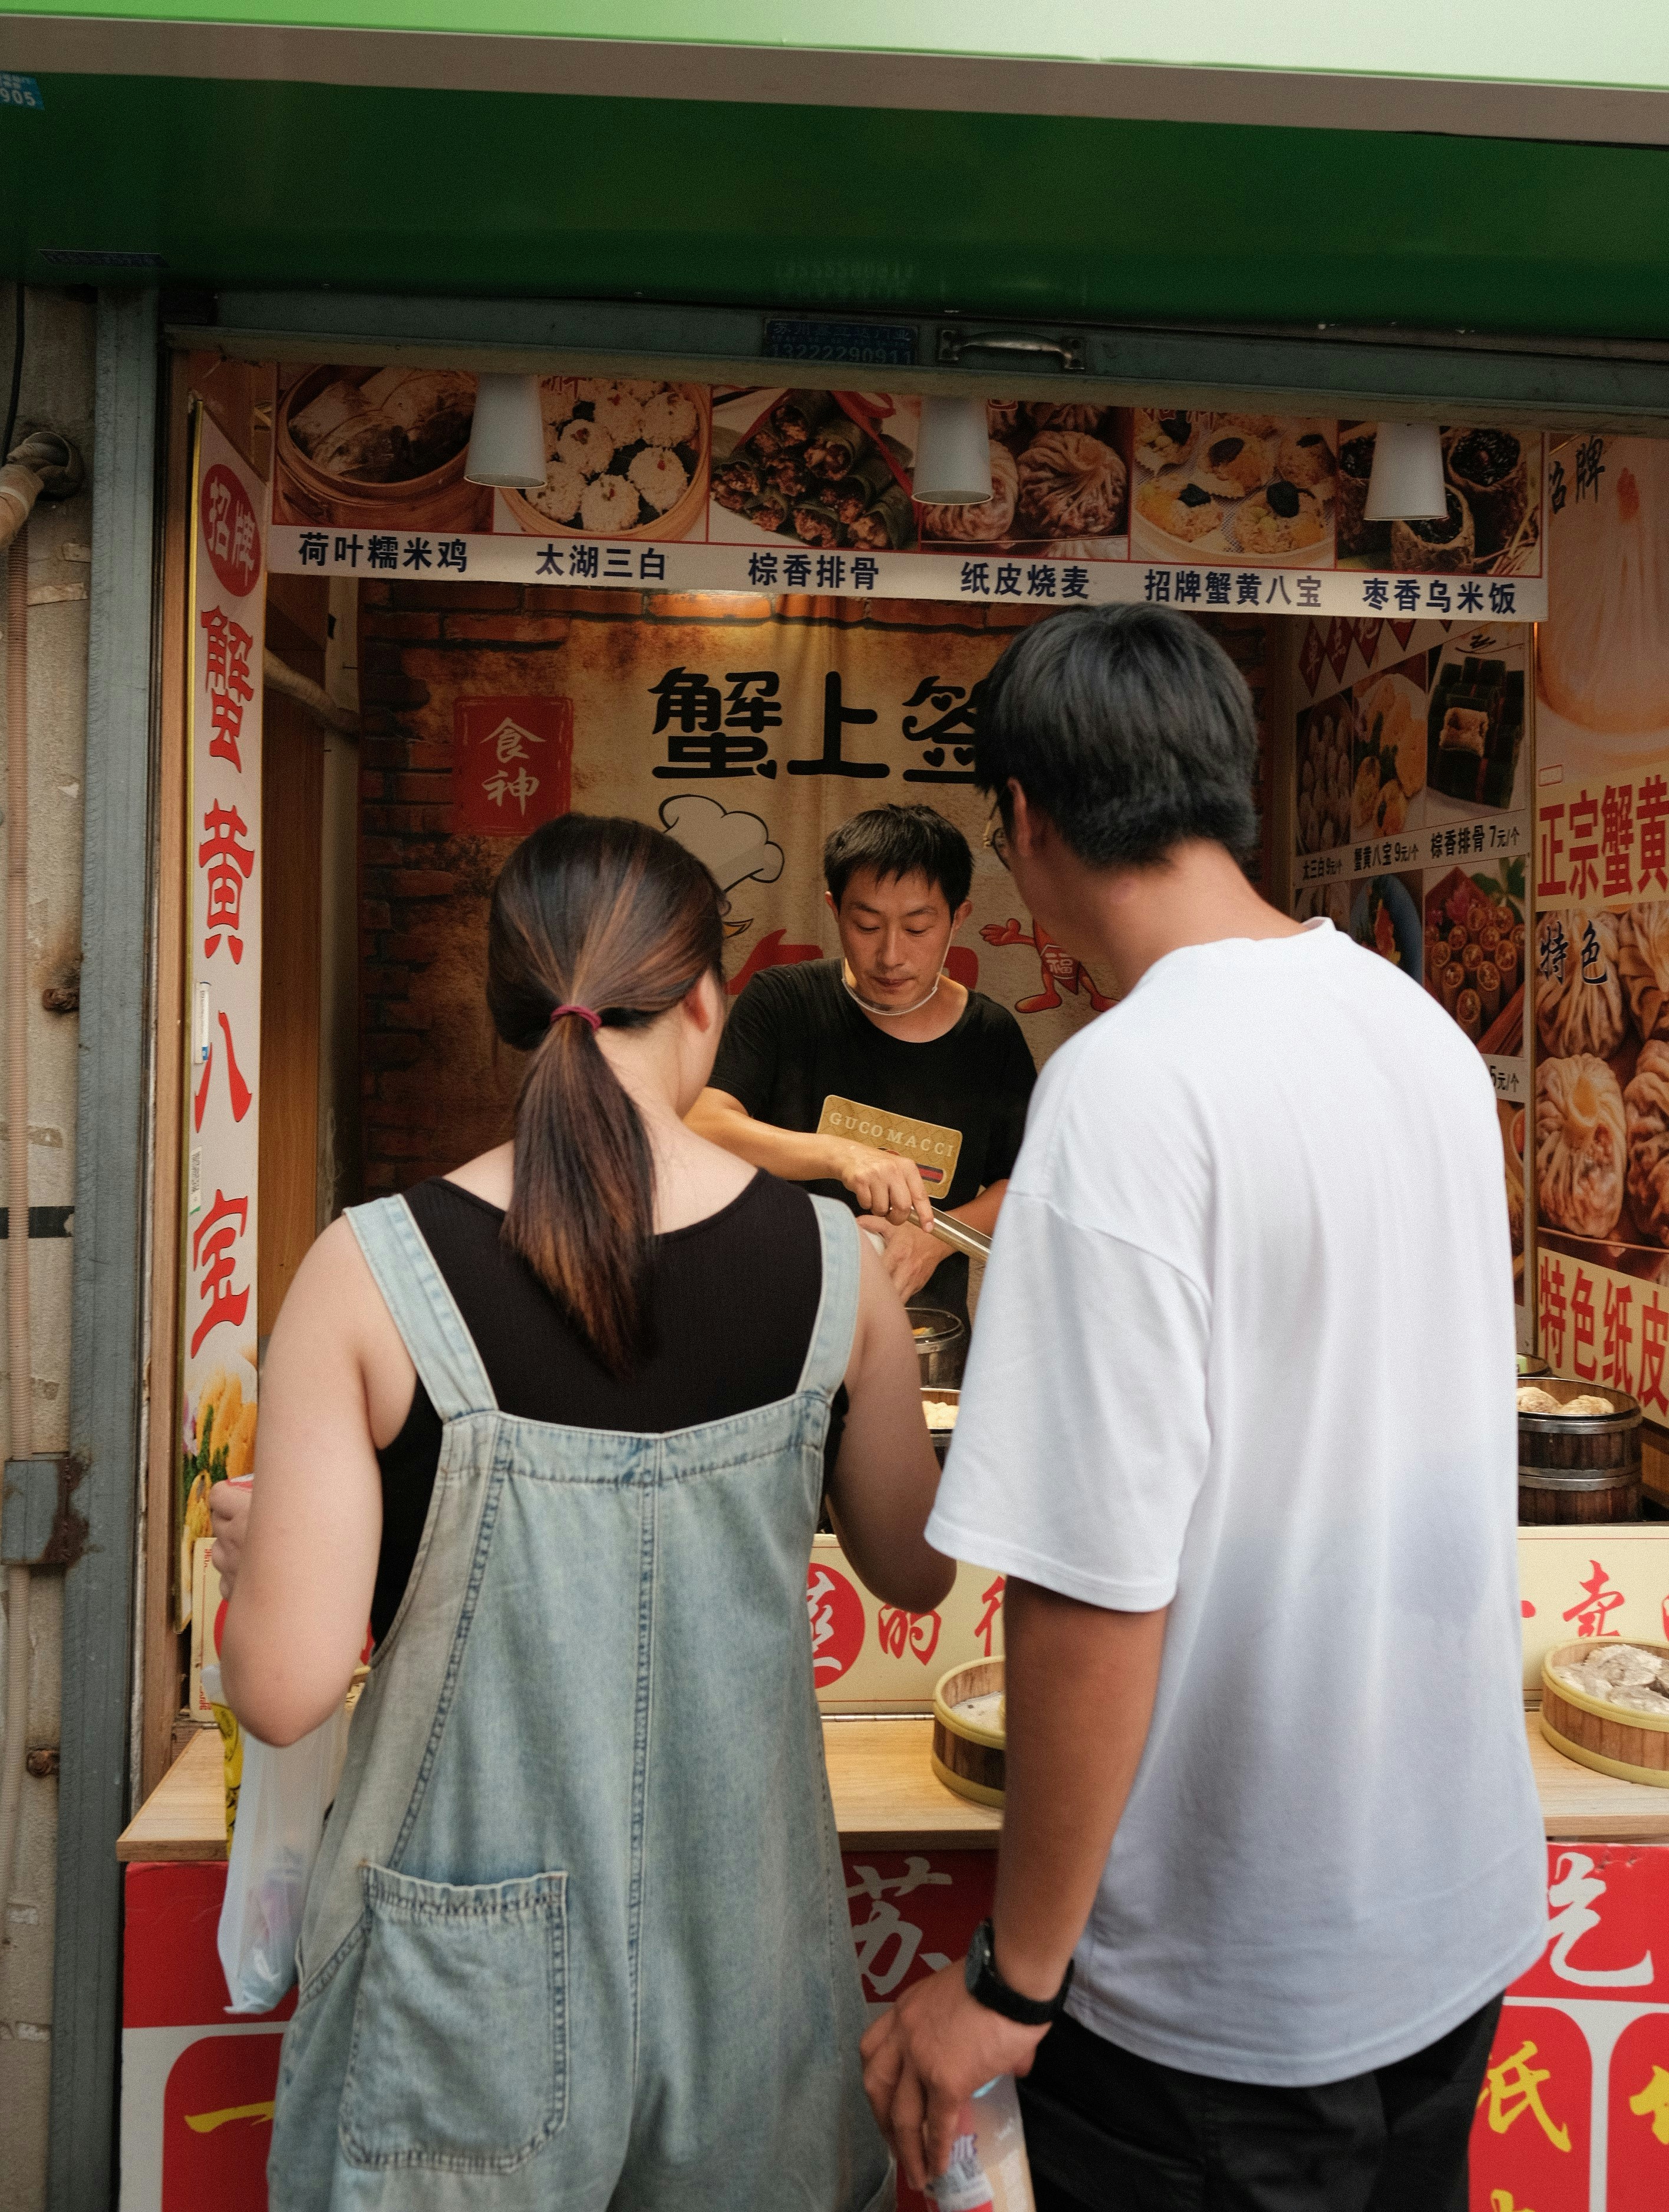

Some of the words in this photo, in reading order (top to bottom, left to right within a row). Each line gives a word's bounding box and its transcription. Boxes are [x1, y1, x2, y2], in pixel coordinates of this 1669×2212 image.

[207, 475, 255, 588] 招牌
[299, 532, 468, 573] 荷叶糯米鸡
[535, 543, 666, 581] 太湖三白
[748, 552, 880, 590] 棕香排骨
[960, 561, 1089, 599] 纸皮烧麦
[1144, 568, 1323, 608] 招牌蟹黄八宝
[1362, 577, 1517, 615] 枣香乌米饭
[479, 716, 546, 816] 食神
[1354, 841, 1392, 872] 蟹黄八宝
[1394, 842, 1420, 862] 9元/个
[1431, 825, 1485, 860] 棕香排骨
[1489, 825, 1520, 849] 7元/个
[1538, 774, 1669, 901] 正宗蟹黄
[1540, 920, 1608, 984] 特色
[190, 605, 255, 1359] 蟹黄八宝
[1538, 1254, 1669, 1417] 特色纸皮
